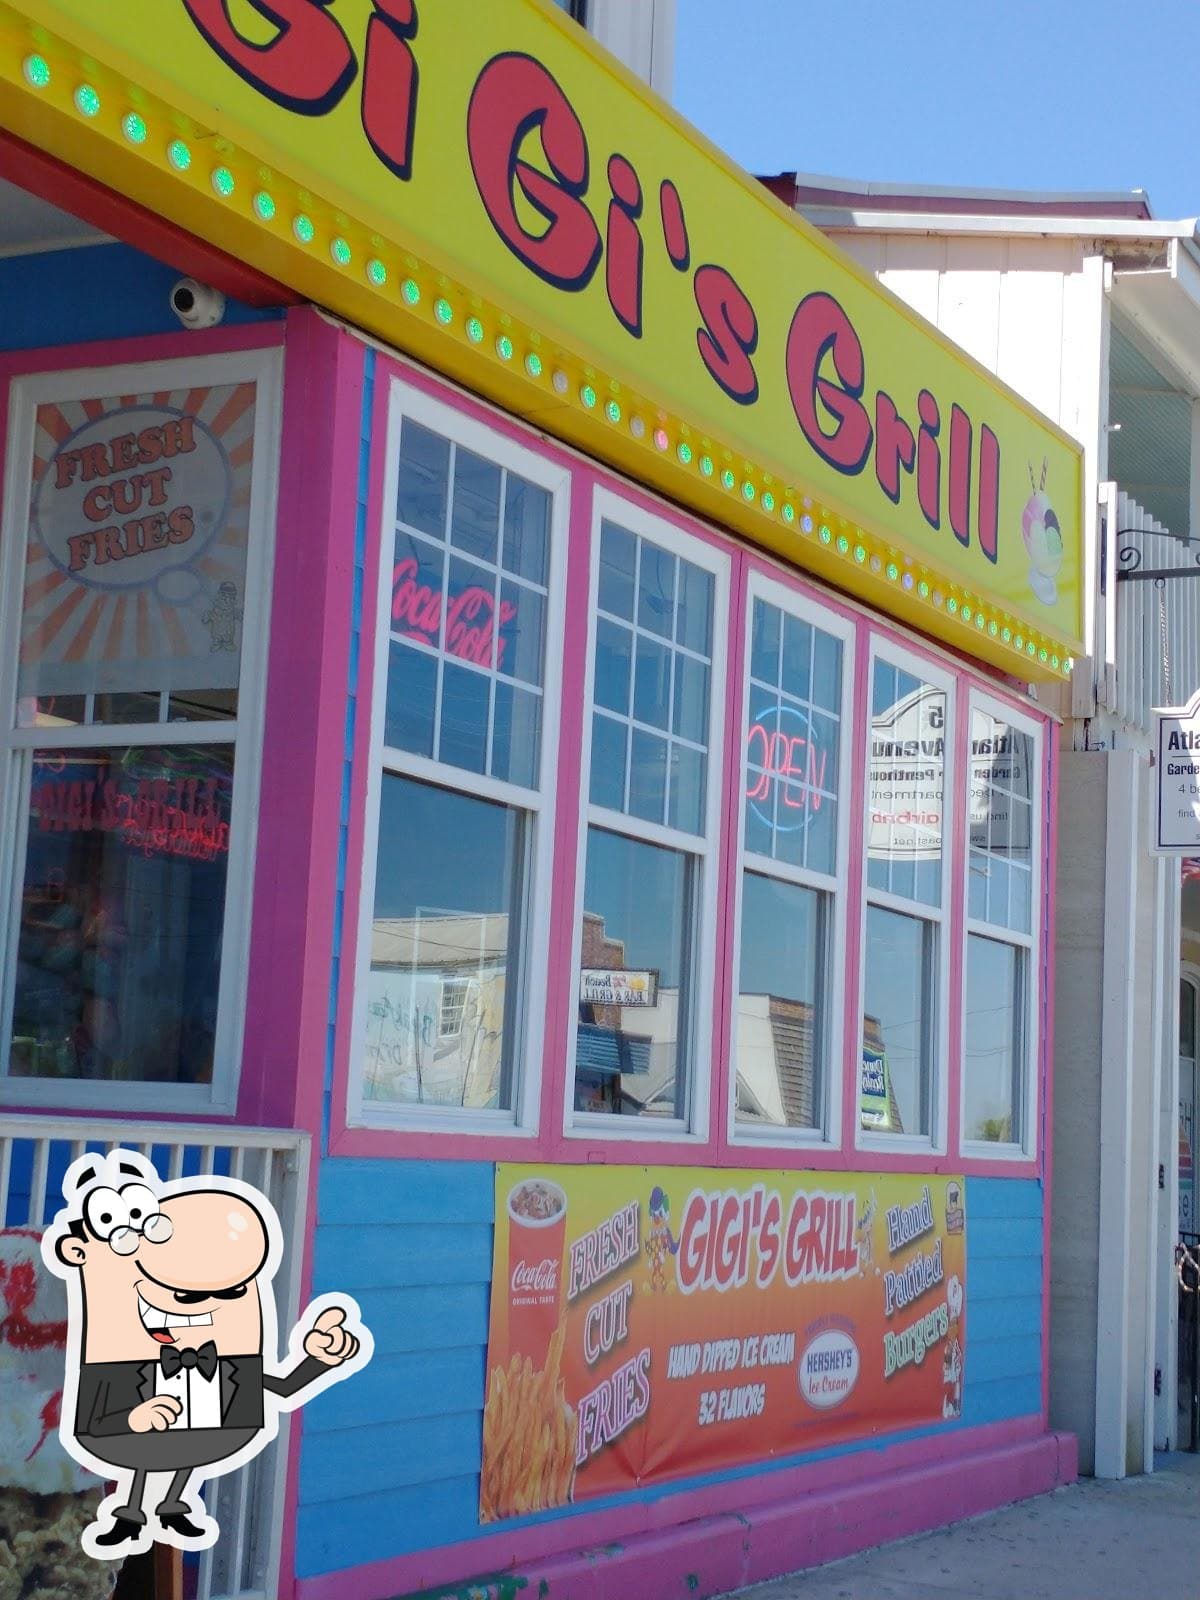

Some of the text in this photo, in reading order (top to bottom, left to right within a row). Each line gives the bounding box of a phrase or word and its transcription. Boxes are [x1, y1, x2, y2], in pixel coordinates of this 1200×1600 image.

[467, 51, 759, 405] Gi's
[786, 291, 1000, 564] Grill
[54, 416, 197, 489] FRESH
[83, 466, 172, 522] CUT
[67, 505, 195, 572] FRIES
[746, 725, 827, 811] OPEN
[567, 1200, 640, 1300] FRESH
[677, 1184, 859, 1293] GIGI'S GRILL
[886, 1184, 933, 1252] Hand
[511, 1259, 559, 1292] Coca-Cola
[884, 1238, 943, 1316] Pattied
[584, 1280, 632, 1364] CUT
[667, 1332, 796, 1380] HAND DIPPED ICE CREAM
[884, 1302, 948, 1377] Burgers
[807, 1350, 852, 1374] HERSHEY'S
[808, 1376, 848, 1395] Ice Cream
[576, 1348, 650, 1466] FRIES
[717, 1383, 765, 1422] FLAVORS
